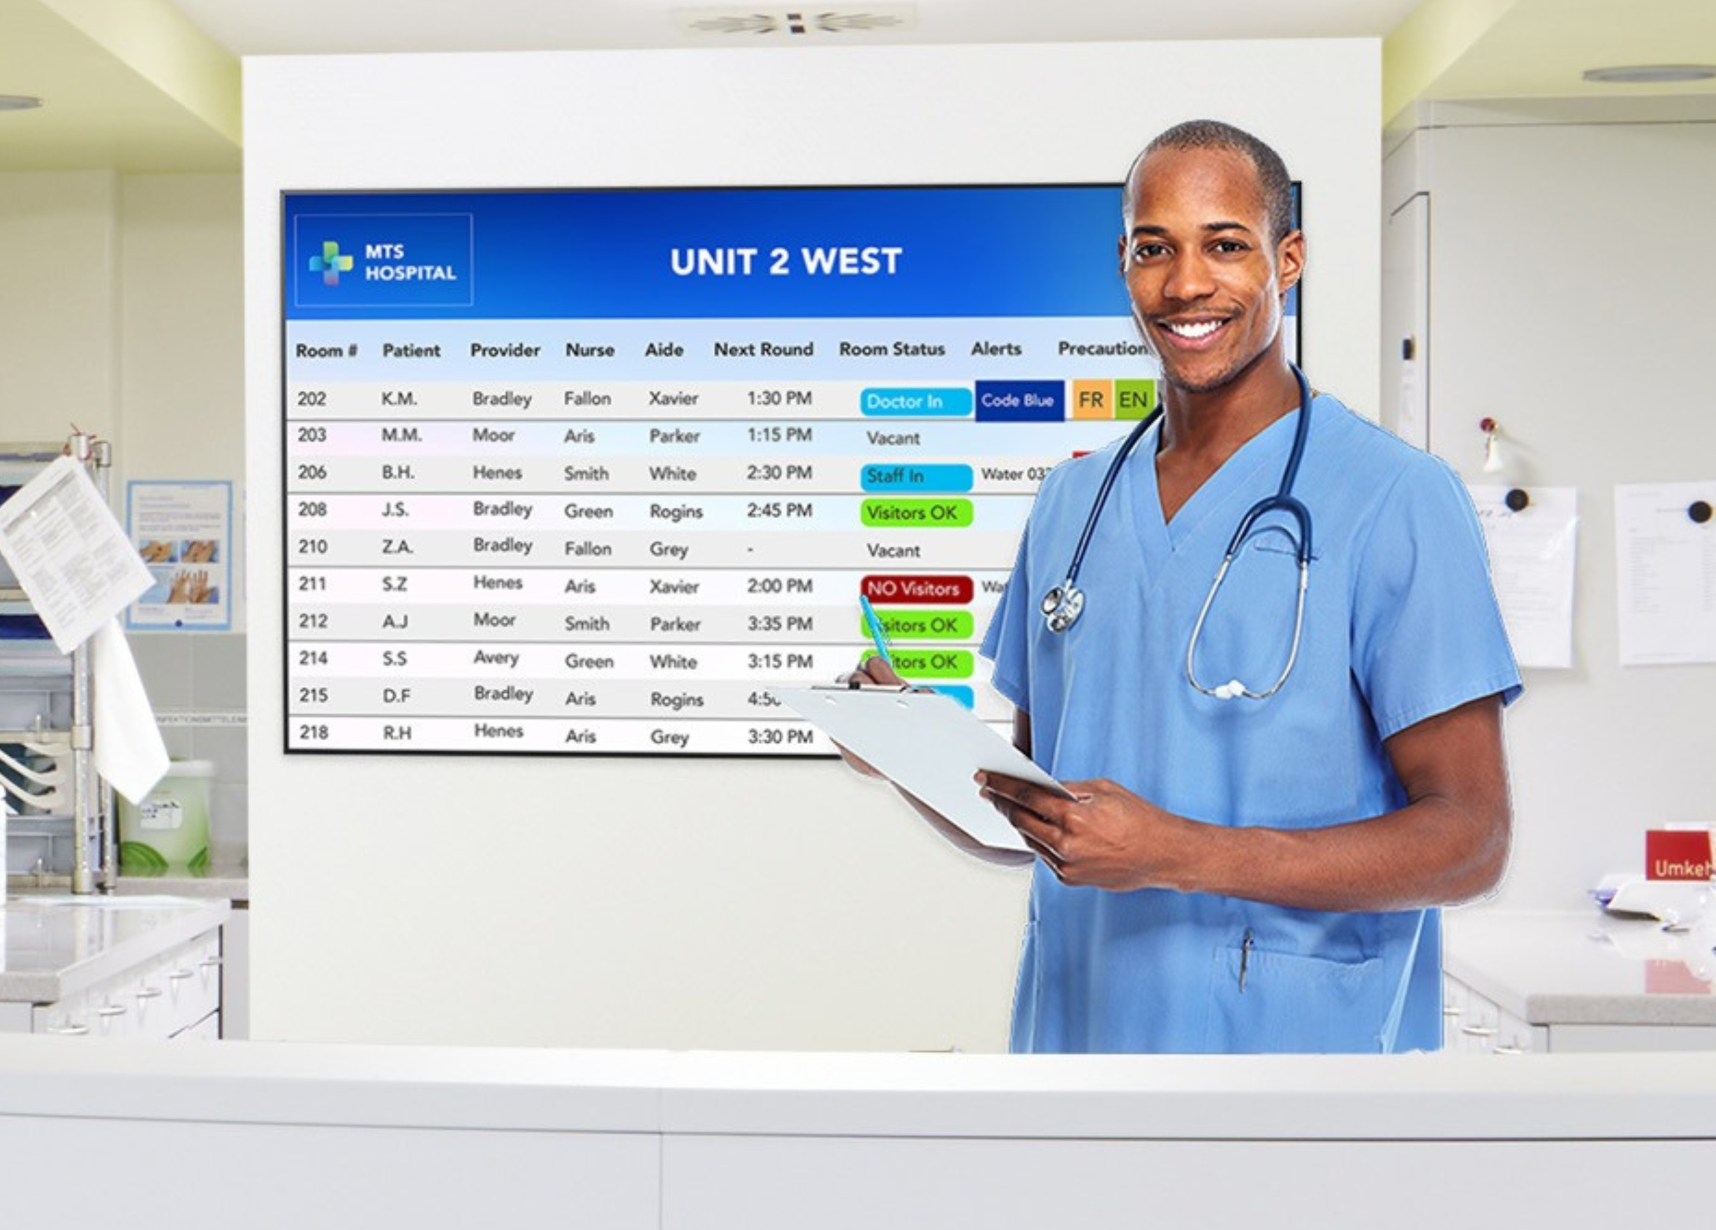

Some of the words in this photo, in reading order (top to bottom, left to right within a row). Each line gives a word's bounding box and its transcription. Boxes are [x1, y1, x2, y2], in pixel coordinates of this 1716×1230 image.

[365, 243, 405, 260] MTS
[671, 248, 758, 276] UNIT
[769, 247, 790, 275] 2
[801, 246, 903, 275] WEST
[365, 265, 456, 281] HOSPITAL
[295, 342, 344, 359] Room
[347, 343, 359, 358] #
[382, 342, 442, 359] Patient
[470, 341, 542, 358] Provider
[565, 342, 616, 358] Nurse
[644, 341, 685, 358] Aide
[713, 341, 756, 358] Next
[760, 340, 815, 358] Round
[839, 341, 889, 358] Room
[892, 340, 947, 357] Status
[970, 340, 1023, 357] Alerts
[1058, 340, 1148, 357] Precaution
[297, 390, 327, 407] 202
[381, 391, 418, 406] K.M.
[472, 390, 533, 410] Bradley
[564, 390, 612, 406] Fallon
[648, 390, 700, 406] Xavier
[747, 389, 782, 406] 1:30
[785, 389, 813, 406] PM
[867, 393, 923, 409] Doctor
[927, 393, 944, 409] In
[981, 393, 1020, 408] Code
[1023, 393, 1055, 408] Blue
[1079, 391, 1104, 408] FR
[1119, 390, 1148, 408] EN
[297, 426, 328, 443] 203
[381, 427, 423, 442] M.M.
[472, 427, 516, 443] Moor
[563, 428, 596, 444] Aris
[649, 427, 701, 444] Parker
[747, 426, 782, 443] 1:15
[785, 426, 813, 442] PM
[866, 430, 921, 447] Vacant
[297, 463, 328, 480] 206
[382, 464, 415, 480] B.H.
[473, 465, 523, 480] Henes
[564, 465, 610, 482] Smith
[648, 465, 698, 482] White
[746, 464, 783, 481] 2:30
[786, 464, 813, 480] PM
[867, 466, 905, 484] Staff
[909, 468, 924, 484] In
[981, 467, 1024, 481] Water
[297, 500, 328, 518] 208
[381, 500, 410, 518] J.S.
[473, 500, 534, 521] Bradley
[563, 502, 614, 520] Green
[649, 502, 705, 524] Rogins
[746, 501, 783, 519] 2:45
[786, 501, 814, 518] PM
[867, 504, 926, 521] Visitors
[930, 504, 958, 520] OK
[298, 538, 329, 555] 210
[382, 538, 414, 555] Z.A.
[473, 536, 534, 557] Bradley
[564, 540, 613, 557] Fallon
[649, 540, 690, 561] Grey
[866, 542, 921, 559] Vacant
[298, 575, 326, 592] 211
[382, 575, 408, 593] S.Z
[473, 574, 524, 591] Henes
[564, 578, 597, 595] Aris
[649, 578, 700, 595] Xavier
[747, 577, 783, 594] 2:00
[786, 577, 814, 594] PM
[867, 580, 897, 597] NO
[900, 580, 960, 597] Visitors
[981, 580, 1006, 594] Wa
[299, 612, 329, 629] 212
[382, 614, 409, 630] A.J
[473, 611, 517, 628] Moor
[564, 615, 611, 632] Smith
[650, 616, 702, 633] Parker
[747, 615, 783, 632] 3:35
[786, 615, 814, 631] PM
[930, 616, 958, 633] OK
[299, 649, 329, 666] 214
[382, 650, 408, 667] S.S
[473, 649, 520, 669] Avery
[564, 652, 615, 670] Green
[649, 653, 699, 670] White
[747, 652, 783, 670] 3:15
[786, 653, 814, 669] PM
[930, 653, 958, 670] OK
[299, 686, 329, 704] 215
[383, 687, 411, 704] D.F
[474, 684, 534, 705] Bradley
[564, 691, 597, 707] Aris
[650, 691, 705, 712] Rogins
[299, 723, 329, 741] 218
[383, 724, 412, 741] R.H
[474, 722, 525, 739] Henes
[564, 728, 598, 745] Aris
[649, 728, 690, 749] Grey
[747, 727, 784, 745] 3:30
[786, 728, 814, 744] PM
